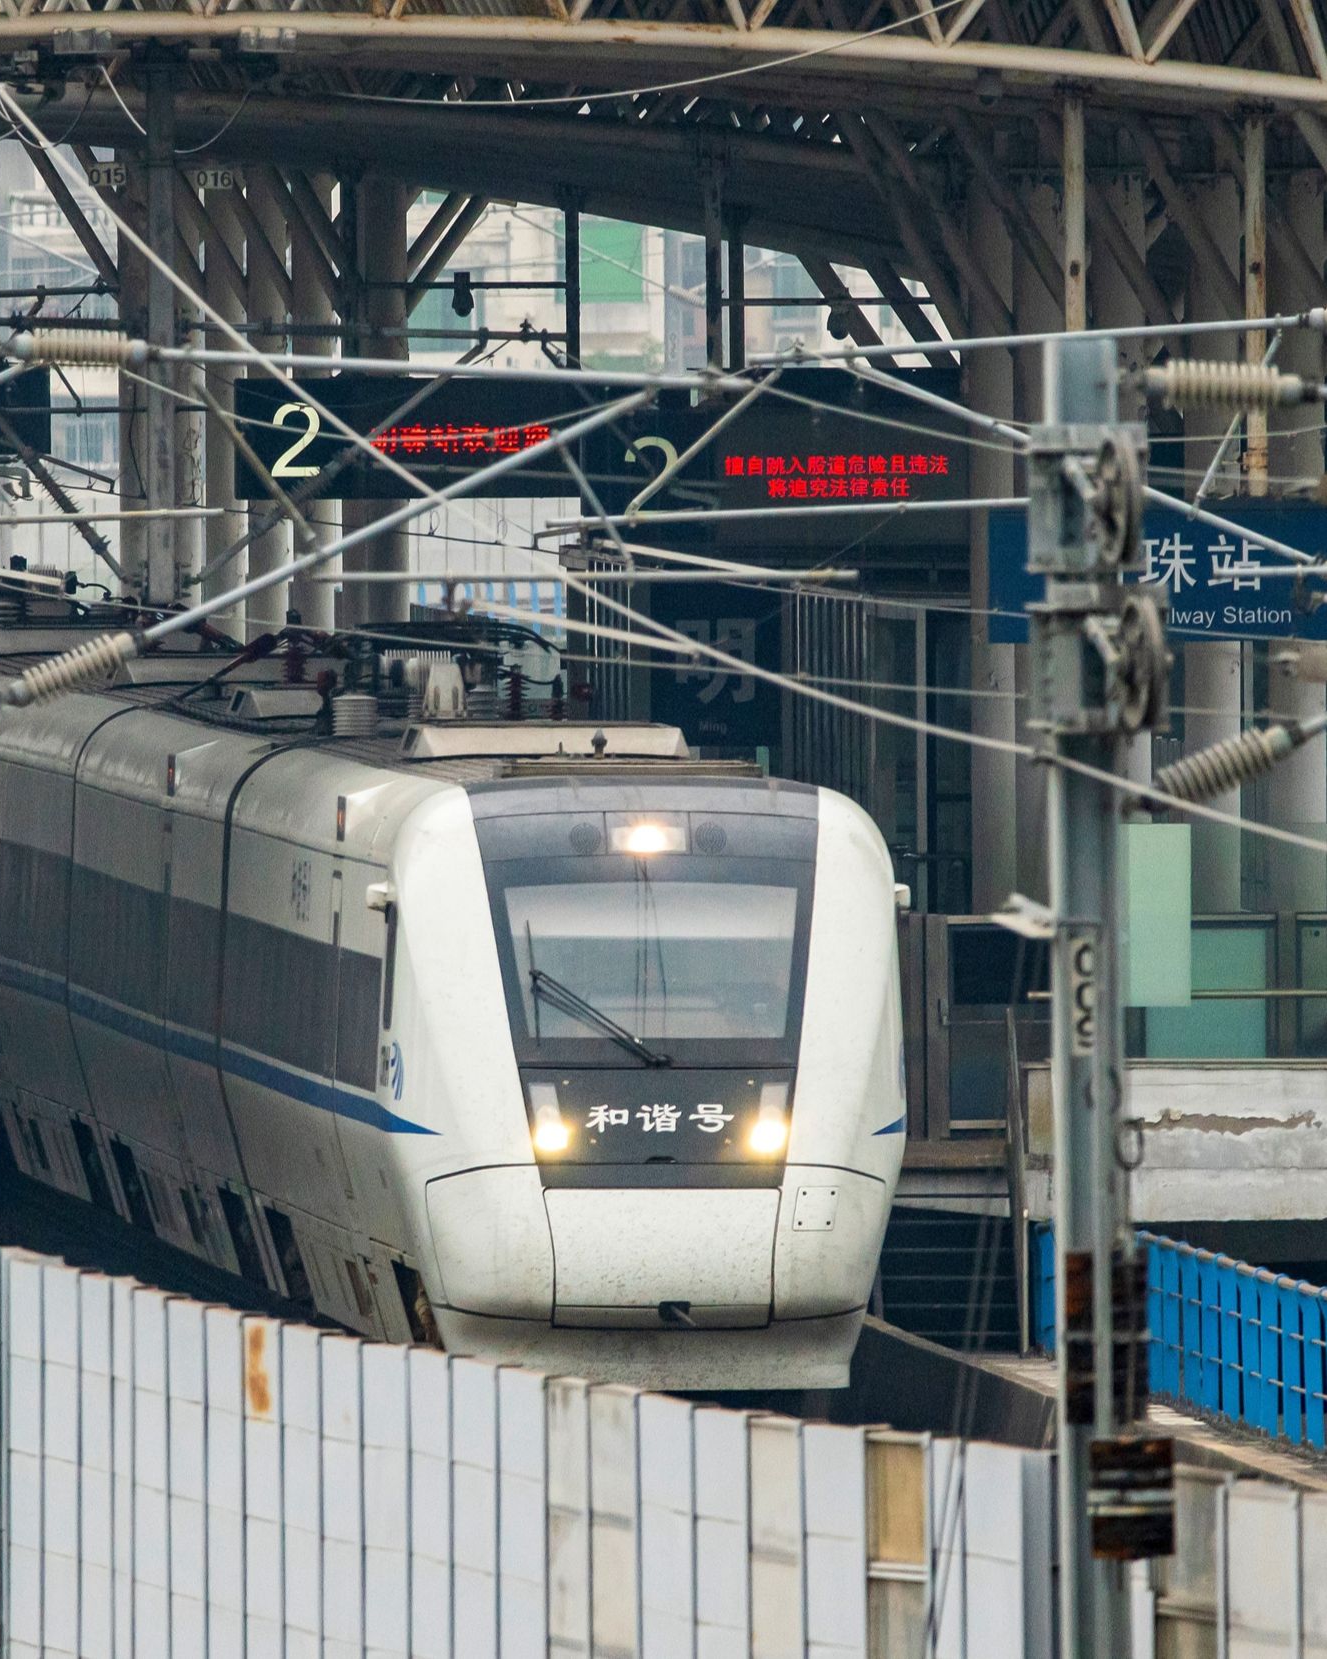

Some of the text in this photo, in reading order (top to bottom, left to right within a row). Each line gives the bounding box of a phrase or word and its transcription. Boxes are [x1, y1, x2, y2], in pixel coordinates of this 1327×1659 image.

[89, 167, 125, 184] 015
[196, 170, 232, 187] 016
[271, 402, 321, 478] 2
[724, 454, 949, 476] 擅自跳入股道危险且违法
[624, 435, 681, 519] 2
[767, 477, 910, 498] 将追究法律责任
[1117, 532, 1265, 594] 珠站
[1223, 605, 1292, 624] Station
[674, 616, 756, 705] 明
[698, 719, 728, 734] Ming
[584, 1102, 736, 1134] 和谐号
